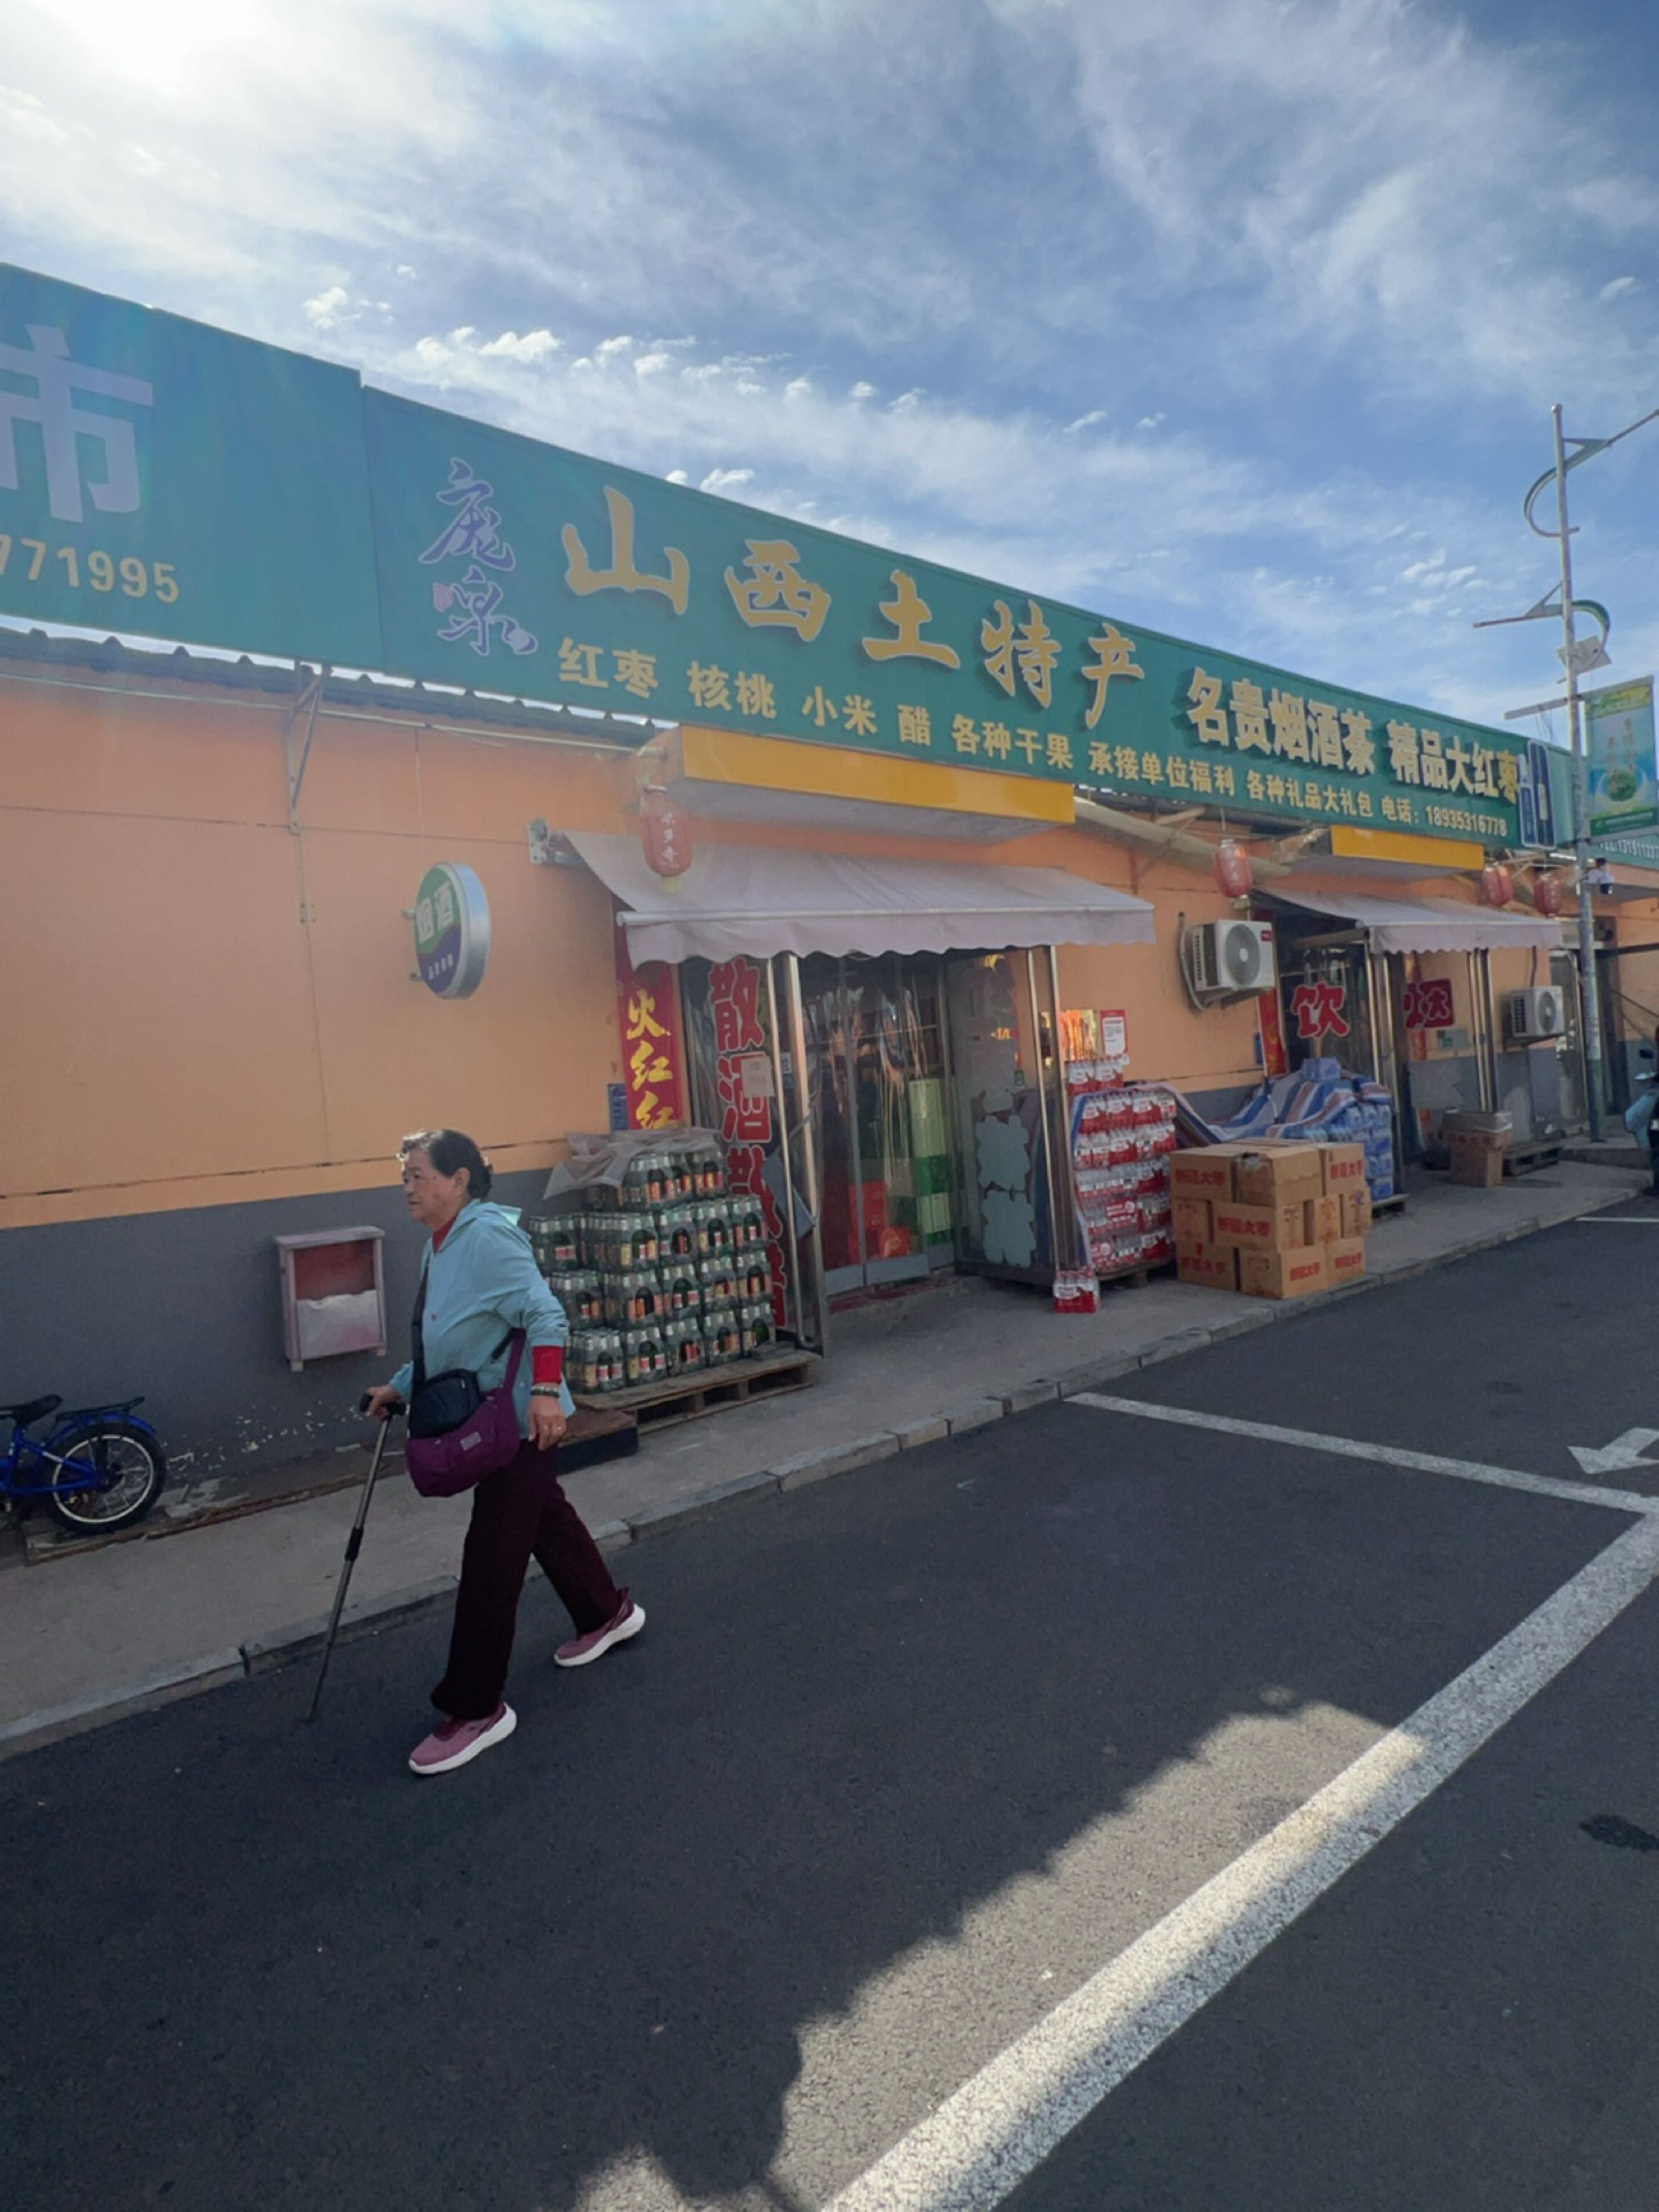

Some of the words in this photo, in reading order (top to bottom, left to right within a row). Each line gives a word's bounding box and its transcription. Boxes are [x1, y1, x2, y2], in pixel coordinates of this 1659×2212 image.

[0, 324, 154, 524] 市
[560, 485, 1144, 728] 山西土特产
[557, 637, 659, 699] 红枣
[686, 661, 777, 719] 核桃
[801, 686, 878, 735] 小米
[897, 704, 931, 747] 醋
[951, 714, 1074, 770] 各种干果
[1089, 741, 1235, 797] 承接单位福利
[1246, 769, 1374, 819] 各种礼品大礼包
[1185, 666, 1375, 775] 名贵烟酒茶
[1292, 982, 1349, 1038] 饮
